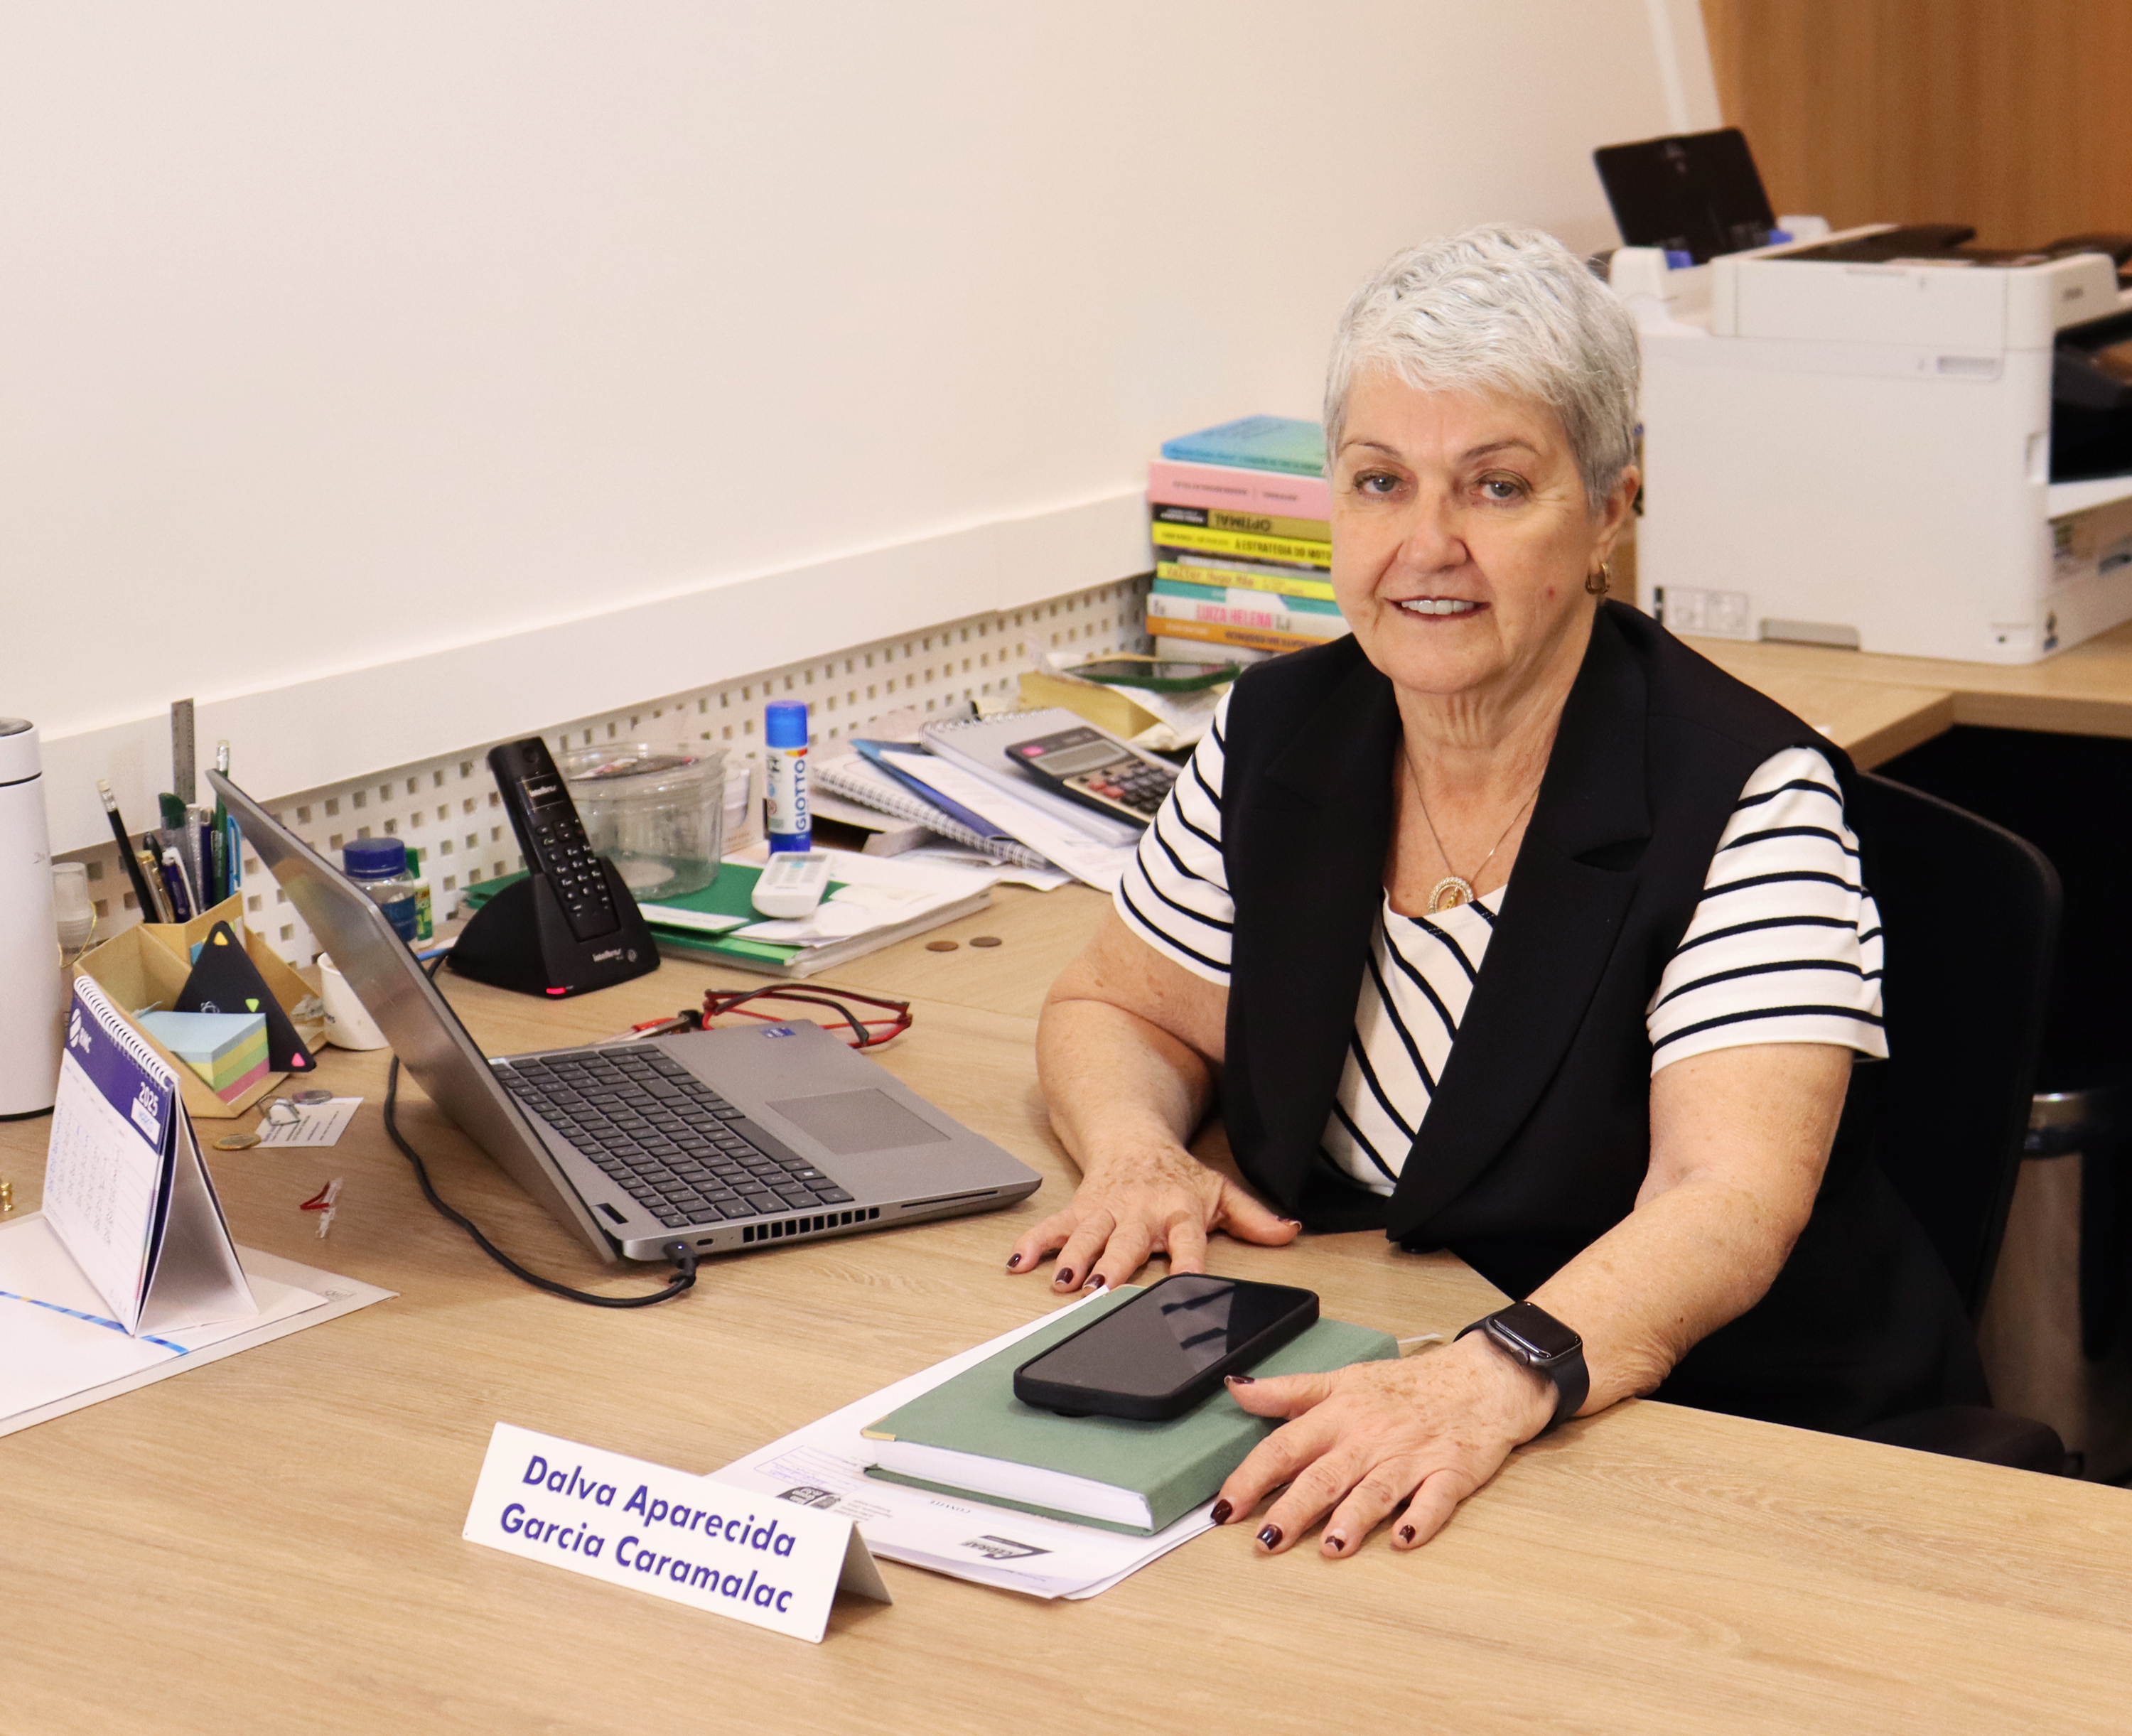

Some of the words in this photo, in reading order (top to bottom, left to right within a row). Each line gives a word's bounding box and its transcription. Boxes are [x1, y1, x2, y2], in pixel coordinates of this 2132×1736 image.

[794, 759, 807, 831] GIOTTO
[139, 1082, 158, 1117] 2025
[522, 1455, 617, 1506] Dalva
[623, 1484, 796, 1558] Aparecida
[928, 1500, 971, 1514] CONVITE
[500, 1502, 605, 1558] Garcia
[615, 1536, 793, 1613] Caramalac
